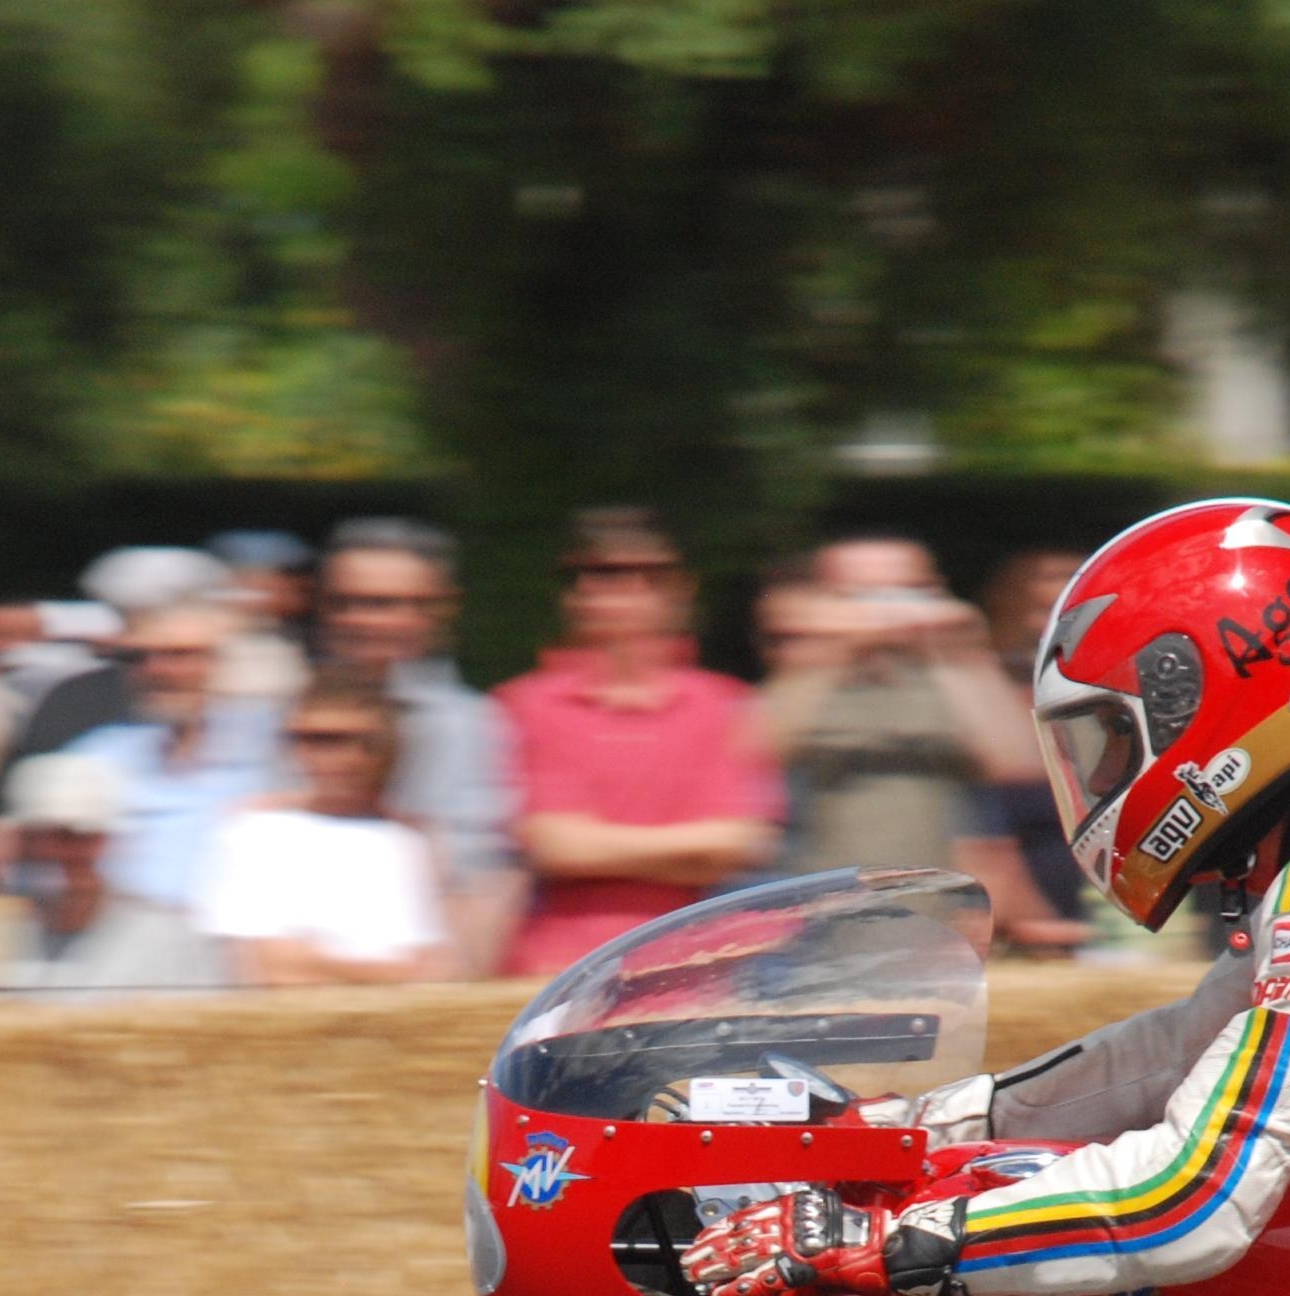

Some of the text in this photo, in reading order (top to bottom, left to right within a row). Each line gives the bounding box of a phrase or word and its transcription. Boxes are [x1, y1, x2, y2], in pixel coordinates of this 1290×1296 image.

[1212, 754, 1242, 789] api
[1148, 804, 1196, 857] agv
[506, 1146, 576, 1207] MV
